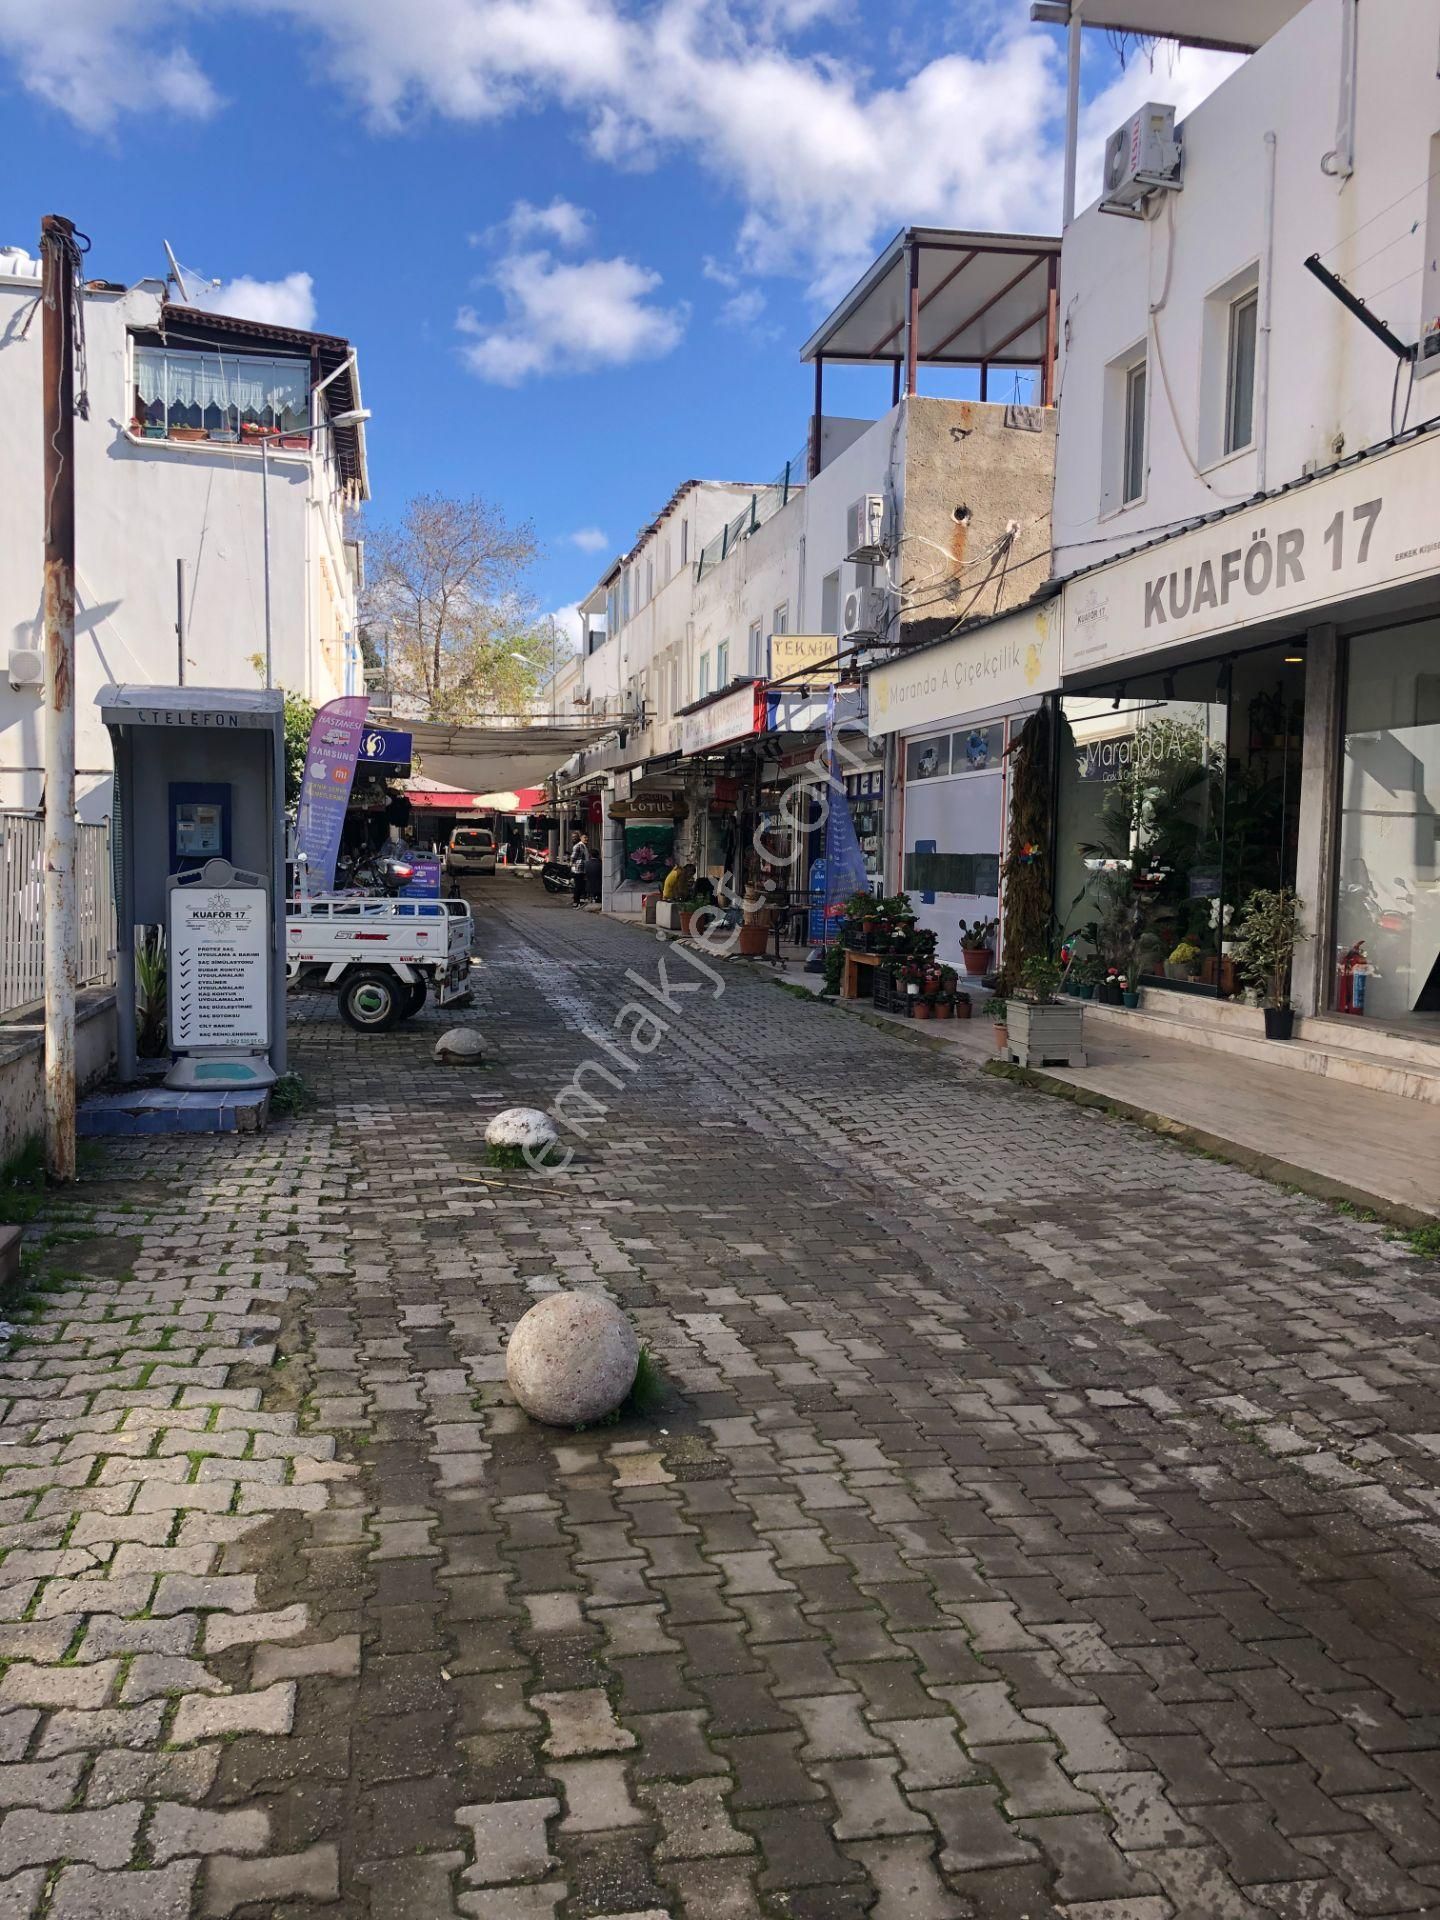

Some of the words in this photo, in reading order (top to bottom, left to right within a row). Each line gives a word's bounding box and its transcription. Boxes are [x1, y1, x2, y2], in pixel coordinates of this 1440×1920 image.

[1144, 527, 1305, 629] KUAFÖR
[1324, 497, 1383, 571] 17
[1394, 548, 1418, 562] ERKEK
[954, 641, 1021, 691] Çiçekçilik
[152, 711, 239, 728] TELEFON
[311, 746, 355, 762] SAMSUNG
[629, 801, 675, 813] LOTUS
[234, 911, 246, 919] 17
